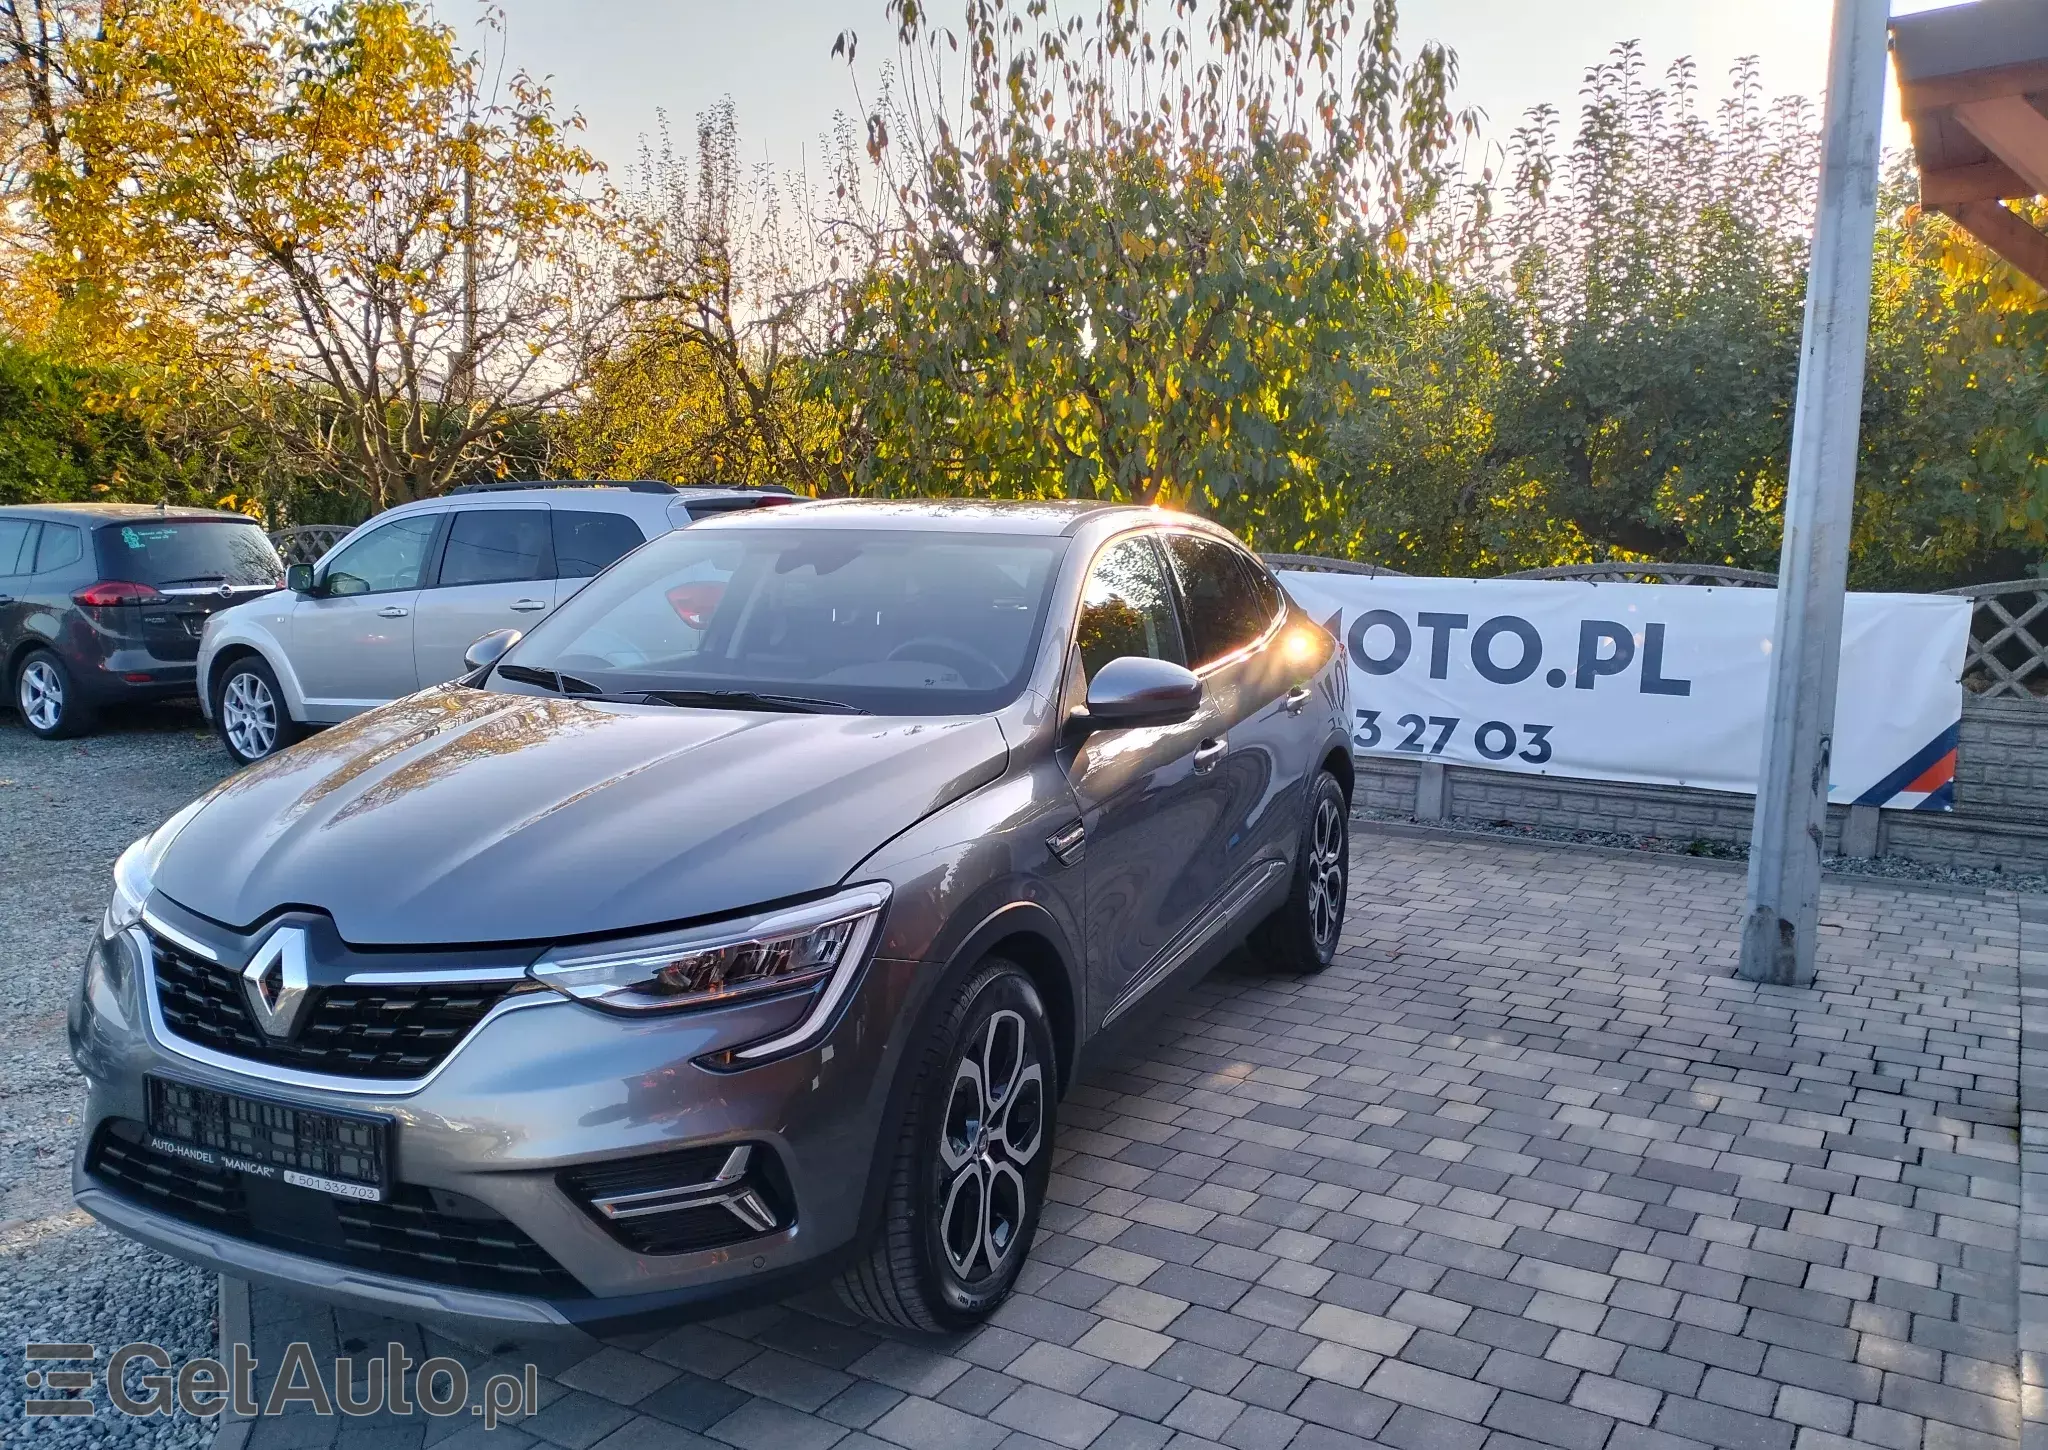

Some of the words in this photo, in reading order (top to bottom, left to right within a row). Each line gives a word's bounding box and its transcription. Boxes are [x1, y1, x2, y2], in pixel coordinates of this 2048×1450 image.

[1394, 713, 1461, 754] 27
[1474, 721, 1554, 765] 03
[151, 1138, 214, 1164] AUTO-HANDEL
[221, 1156, 274, 1177] "MANICAR"
[298, 1175, 321, 1189] 501
[324, 1181, 347, 1194] 332
[350, 1186, 375, 1199] 703
